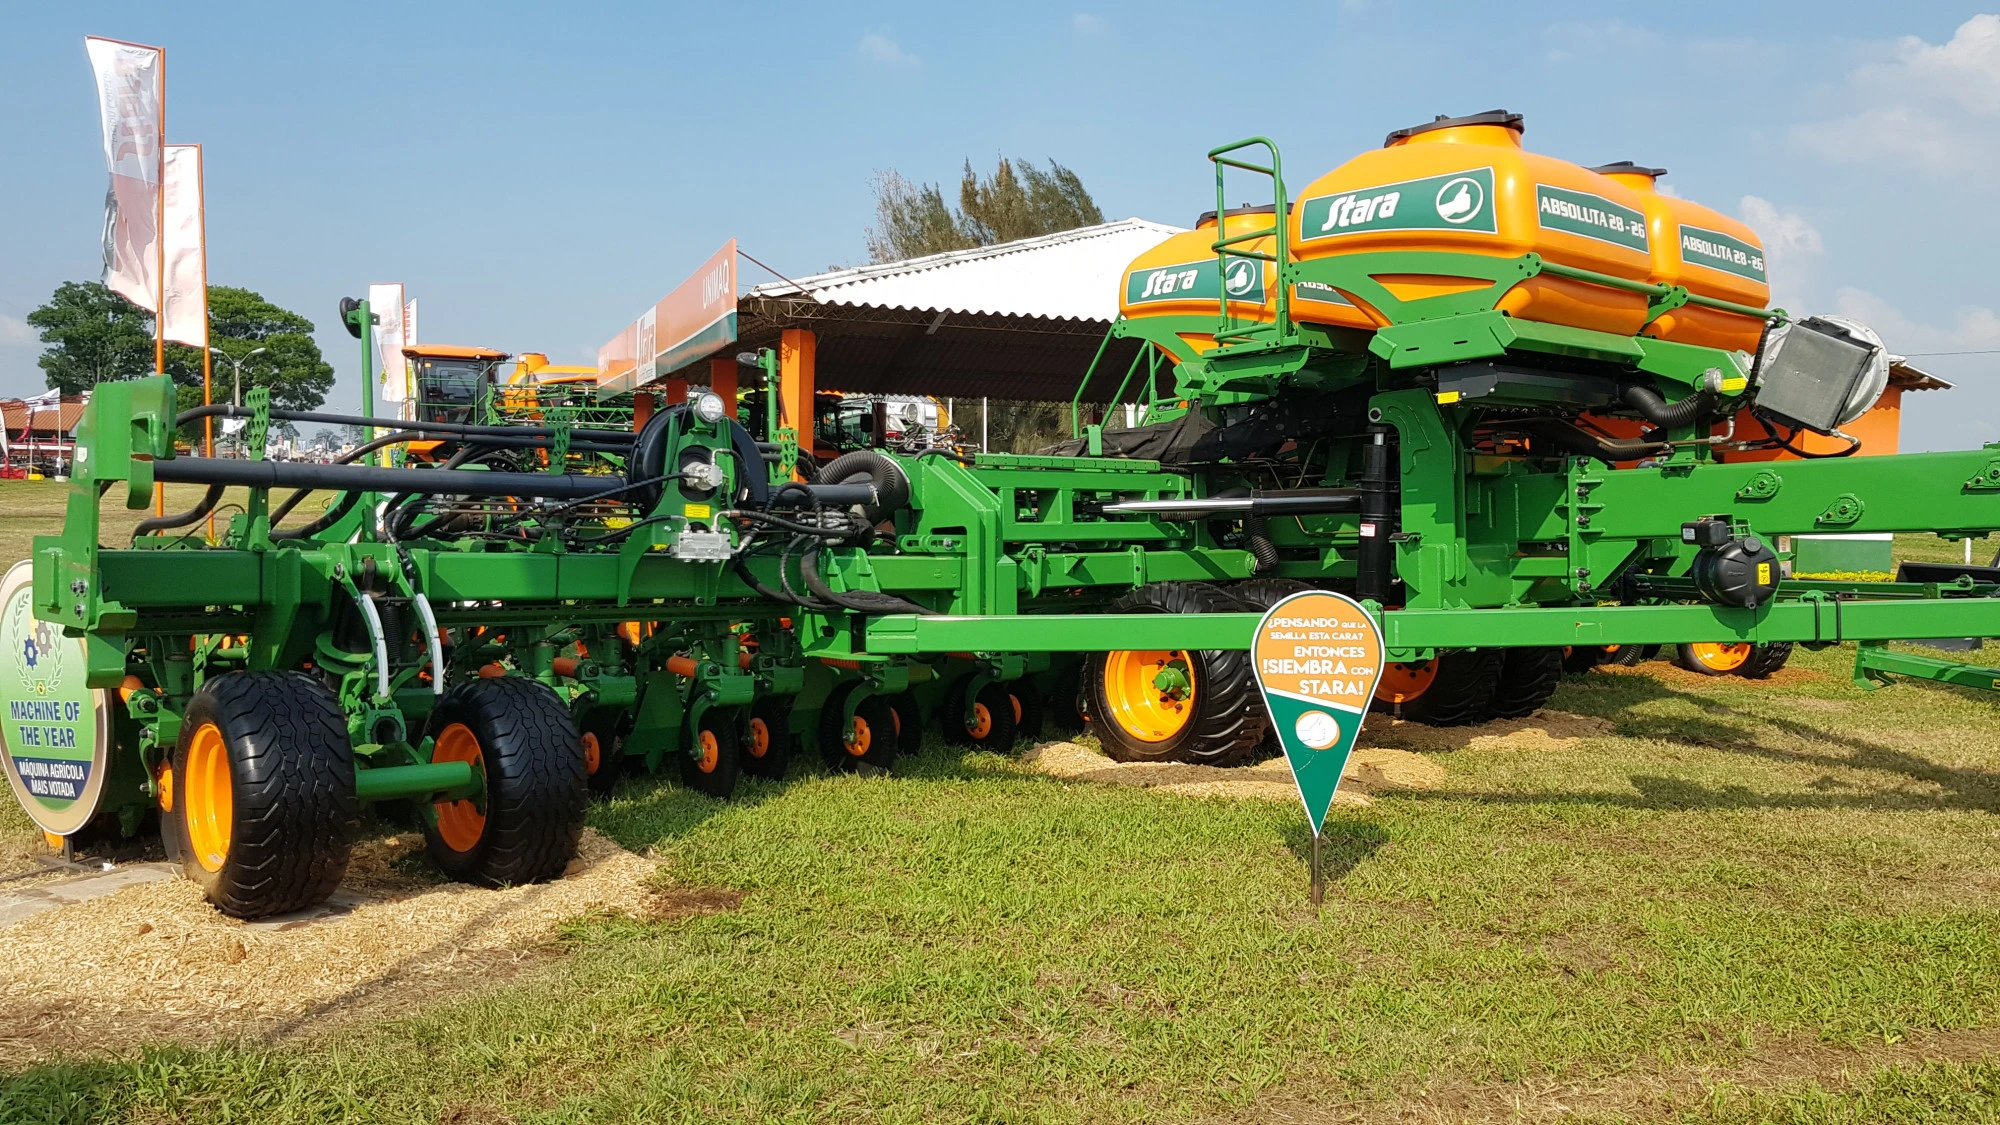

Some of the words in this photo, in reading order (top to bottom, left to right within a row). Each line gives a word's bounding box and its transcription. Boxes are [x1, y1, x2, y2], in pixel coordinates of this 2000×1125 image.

[1321, 191, 1400, 232] Stara
[1540, 196, 1608, 228] ABSOLUTA
[1682, 235, 1733, 262] ABSOLUTA
[702, 258, 730, 310] UNIMAQ
[1141, 269, 1198, 299] Stara
[1267, 617, 1338, 628] ¿PENSANDO
[1270, 632, 1307, 640] SEMILLA
[1309, 632, 1330, 640] ESTA
[1332, 632, 1363, 640] CARA?
[1294, 646, 1365, 658] ENTONCES
[1350, 667, 1374, 675] CON
[1299, 680, 1364, 696] STARA!
[10, 700, 61, 721] MACHINE
[64, 701, 80, 722] OF
[20, 726, 41, 746] THE
[43, 727, 76, 748] YEAR
[19, 758, 49, 778] MÁQUINA
[50, 761, 85, 780] AGRÍCOLA
[31, 779, 48, 795] MAIS
[48, 780, 76, 797] VOTADA
